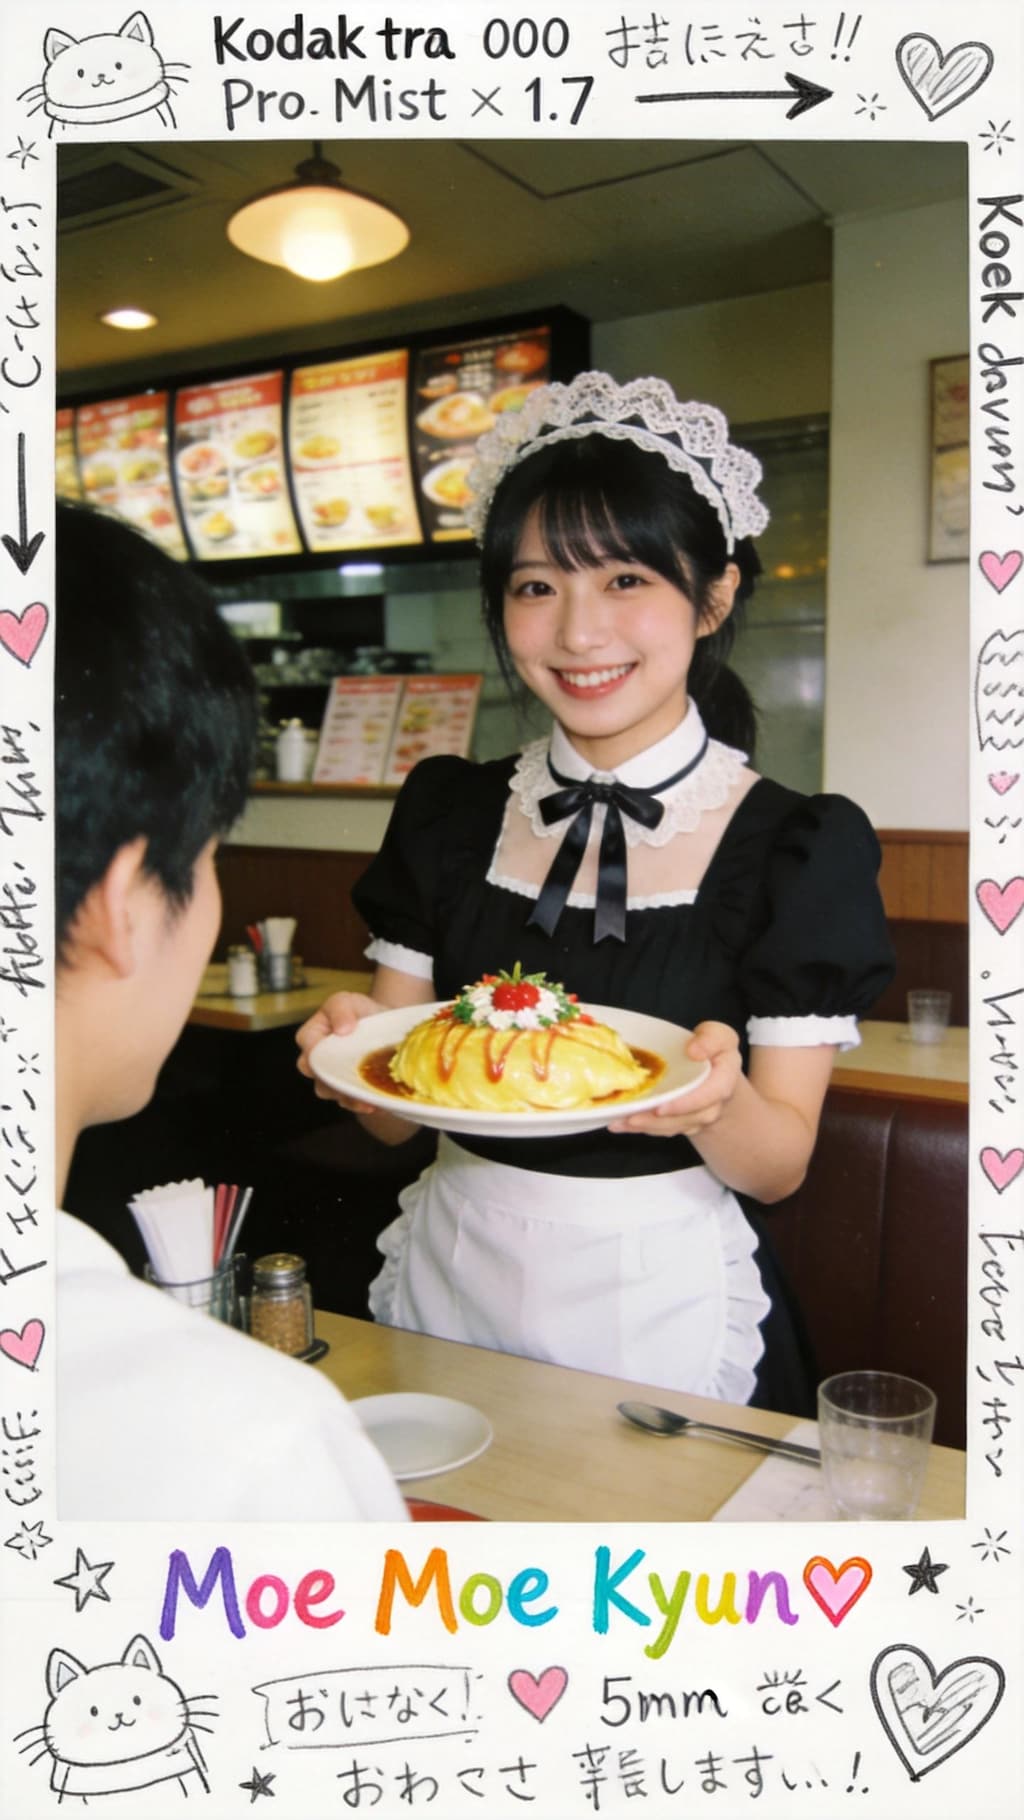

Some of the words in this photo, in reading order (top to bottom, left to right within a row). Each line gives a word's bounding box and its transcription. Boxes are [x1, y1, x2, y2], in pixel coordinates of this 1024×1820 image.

[214, 13, 367, 66] Kodak
[376, 16, 457, 61] tra
[482, 17, 570, 61] 000
[334, 74, 448, 123] Mist
[524, 75, 595, 126] 1.7
[159, 1546, 346, 1642] Moe
[373, 1546, 560, 1637] Moe
[591, 1545, 800, 1661] Kyun
[600, 1676, 728, 1728] 5mm
